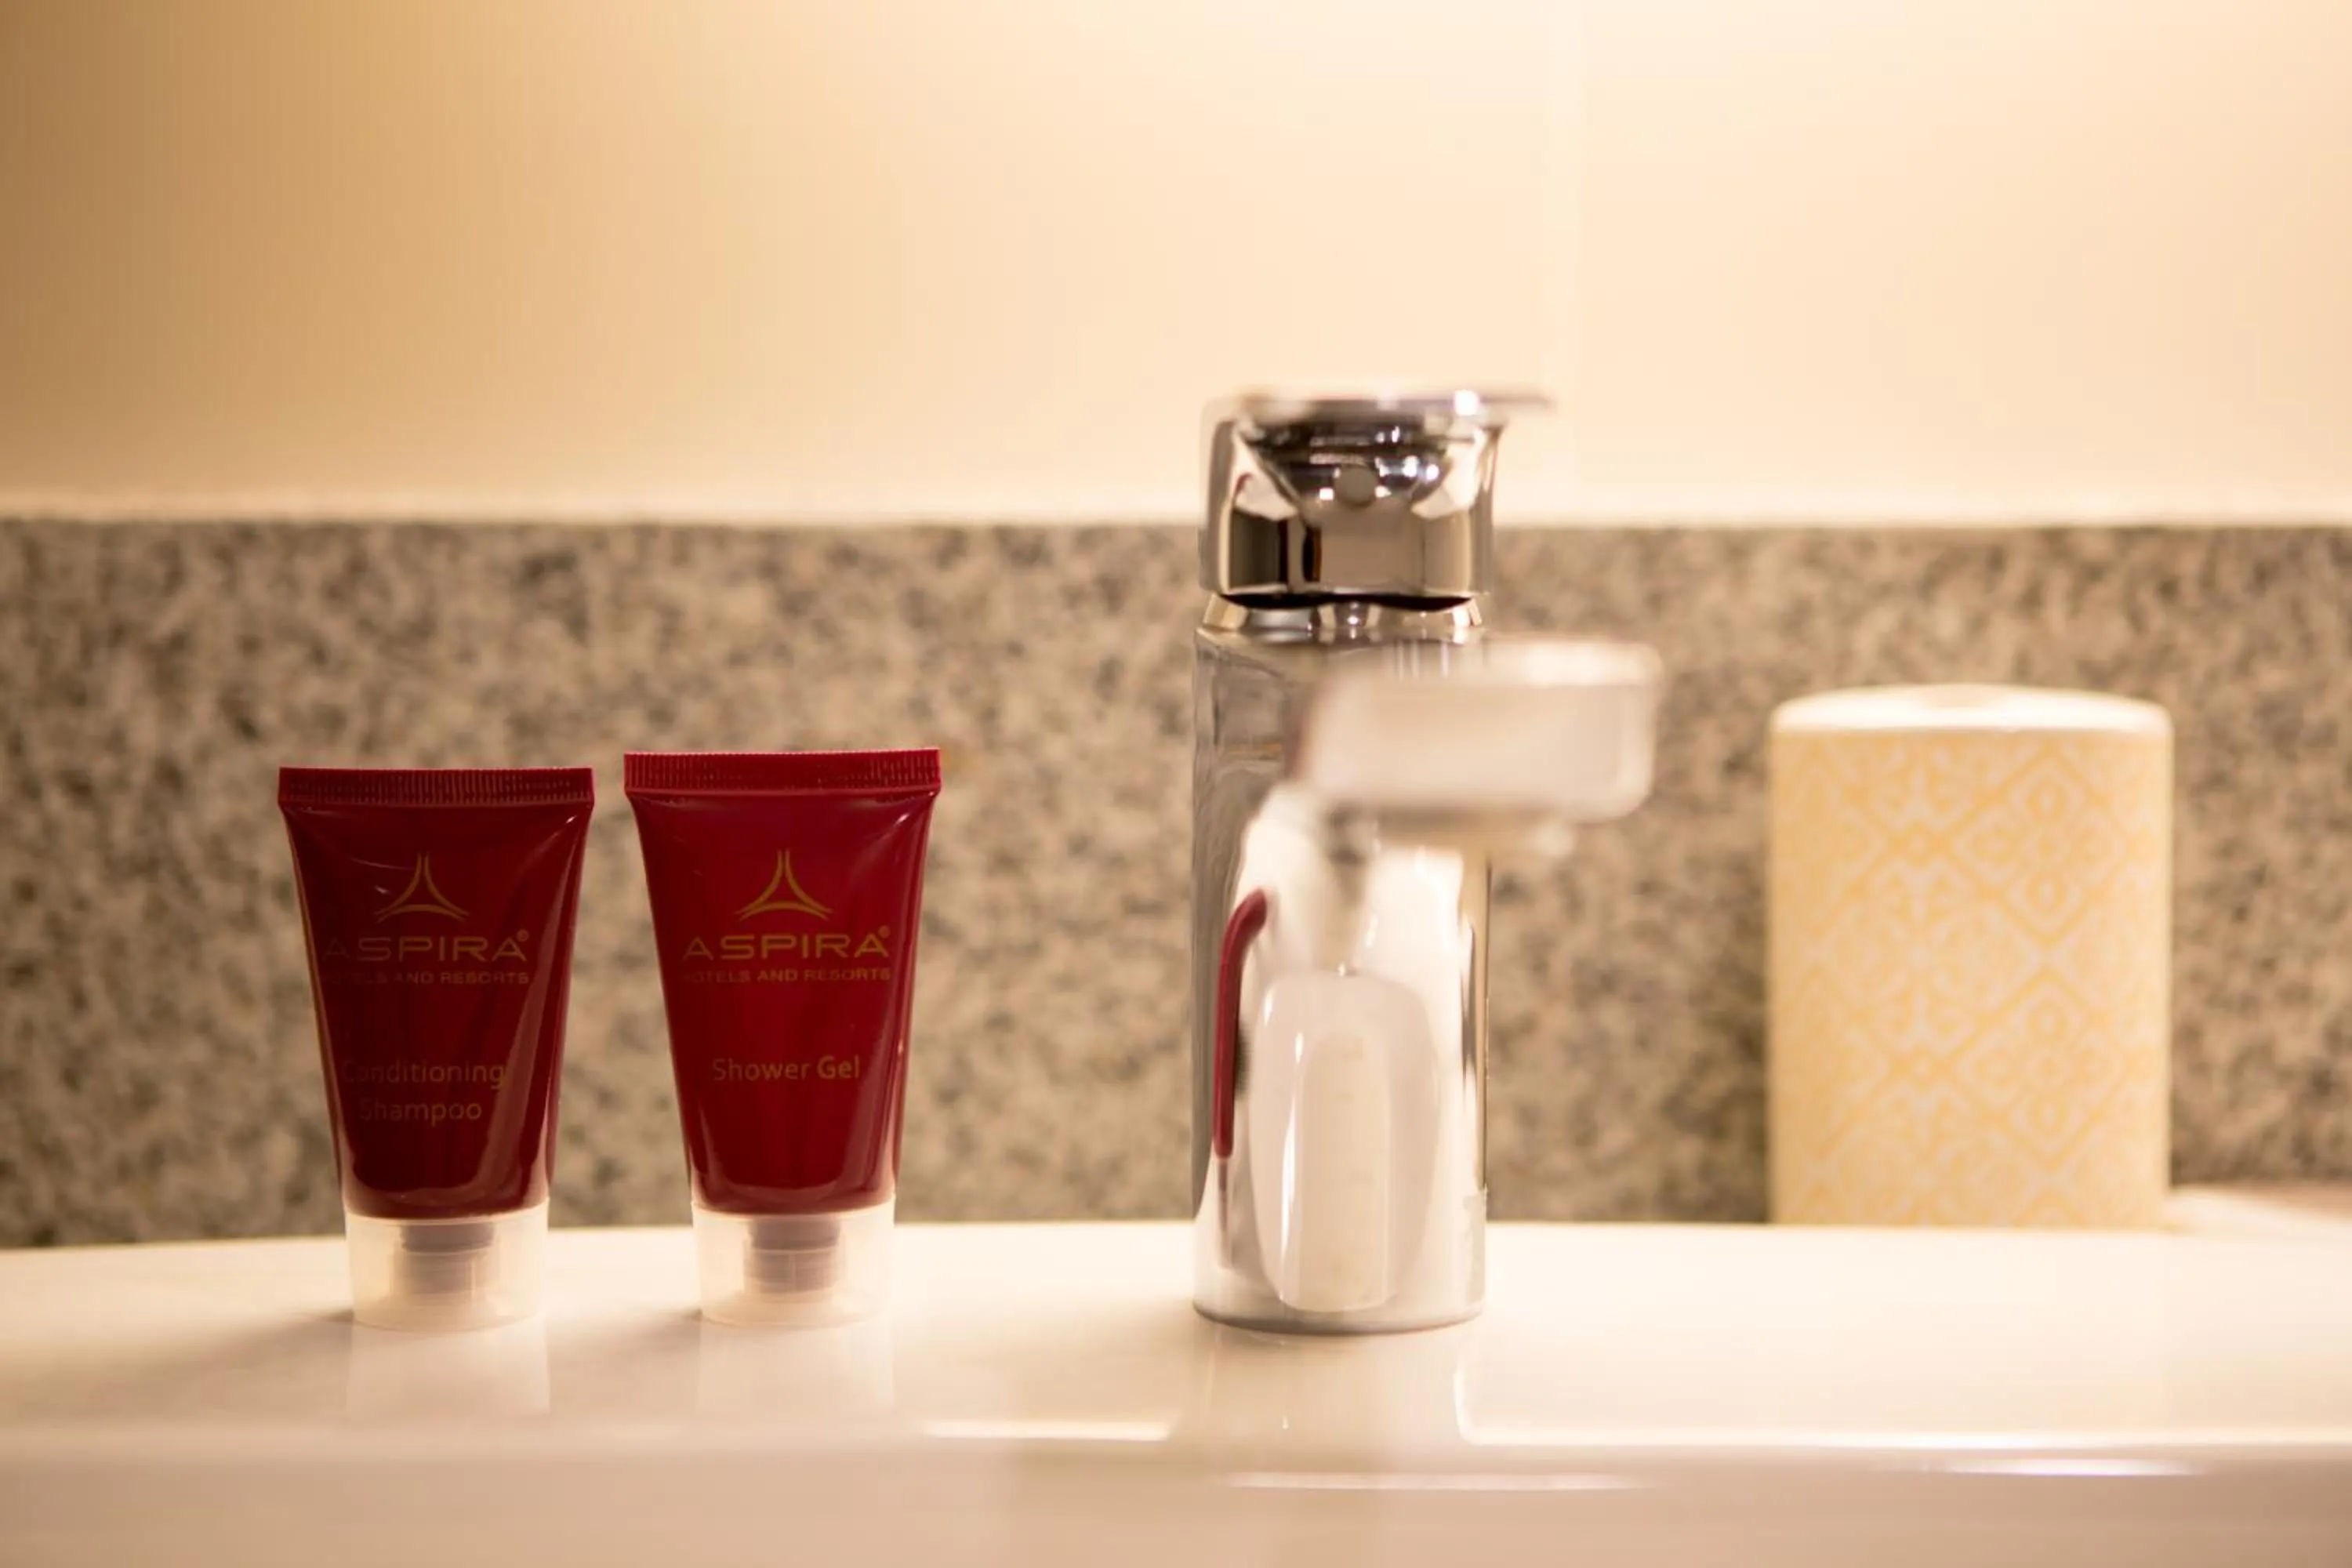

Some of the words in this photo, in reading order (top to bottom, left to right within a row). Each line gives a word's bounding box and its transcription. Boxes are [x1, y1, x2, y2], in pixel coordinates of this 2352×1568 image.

[321, 971, 388, 985] TELS
[393, 971, 434, 985] AND
[440, 971, 530, 985] RESORTS
[757, 968, 798, 983] AND
[804, 967, 891, 982] RESORTS
[342, 1058, 505, 1091] Conditioning
[712, 1056, 811, 1081] Shower
[816, 1054, 860, 1080] Gel
[359, 1097, 483, 1128] Shampoo
